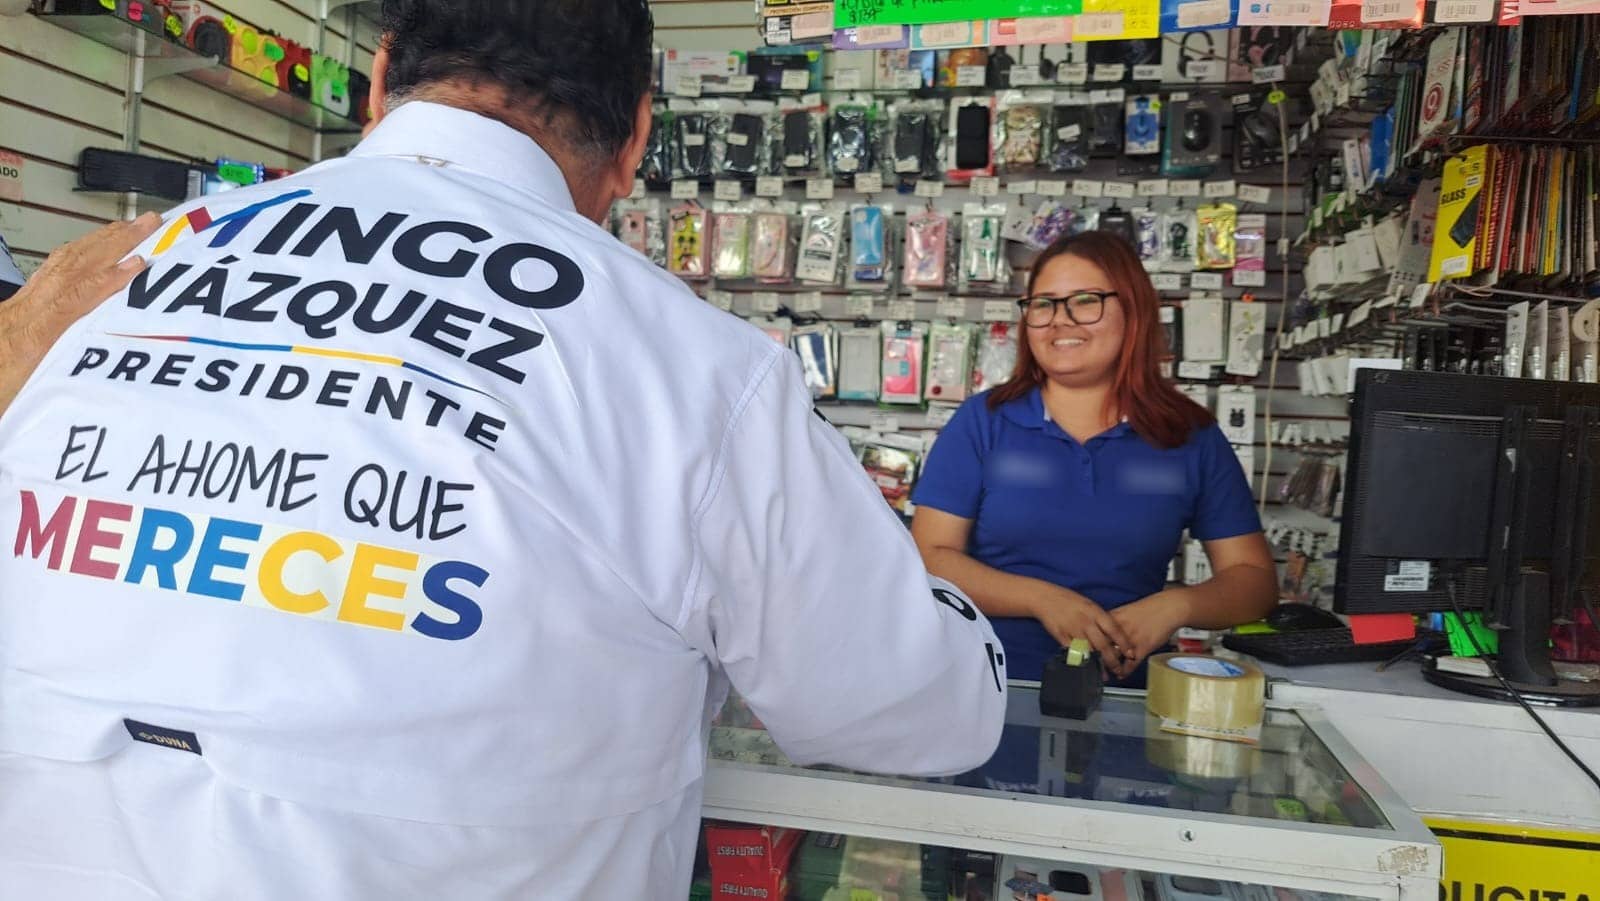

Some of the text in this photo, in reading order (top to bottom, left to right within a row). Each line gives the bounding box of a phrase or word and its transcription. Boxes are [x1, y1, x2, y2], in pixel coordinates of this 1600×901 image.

[152, 190, 584, 309] MINGO
[127, 254, 545, 385] VÁZQUEZ
[70, 347, 506, 452] PRESIDENTE
[55, 425, 475, 541] EL AHOME QUE
[14, 490, 490, 641] MERECES
[717, 845, 765, 857] QUALITY FIRST
[719, 883, 769, 899] QUALITY FIRST
